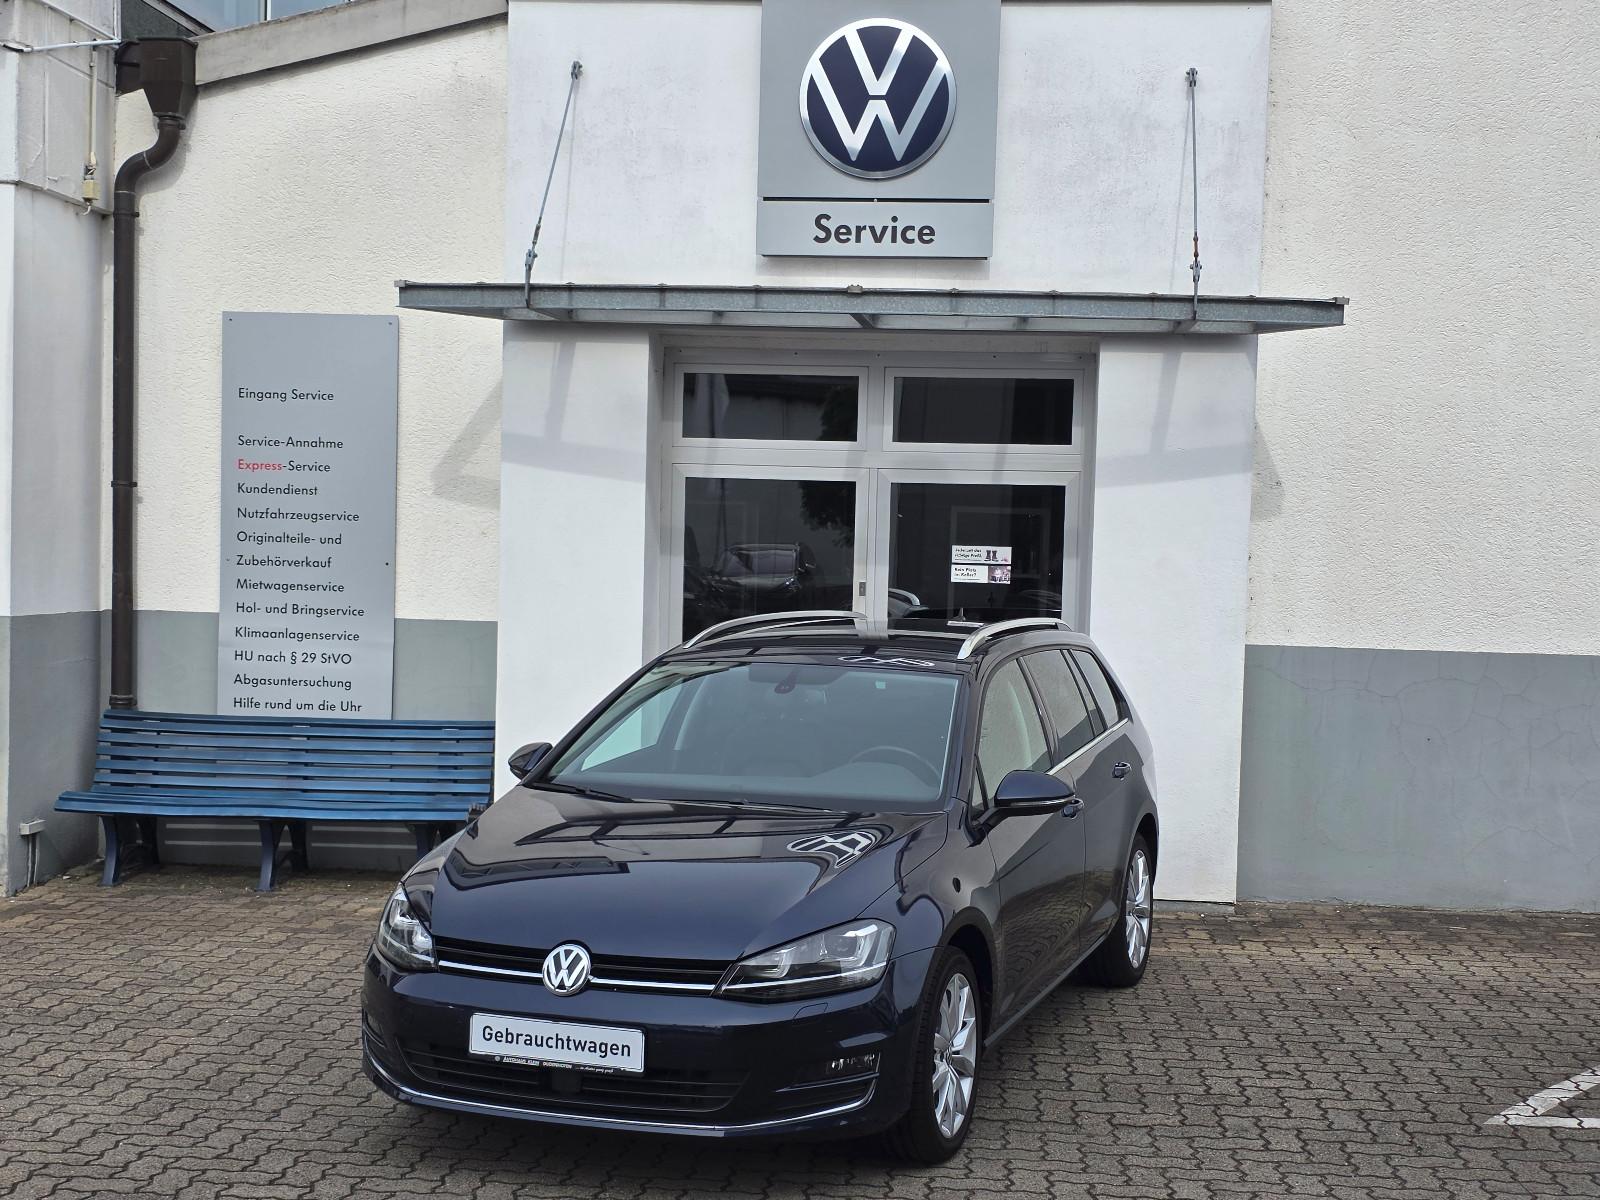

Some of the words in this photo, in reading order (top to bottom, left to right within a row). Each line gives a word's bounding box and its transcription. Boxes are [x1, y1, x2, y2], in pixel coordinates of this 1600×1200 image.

[803, 21, 953, 173] VW
[813, 213, 936, 244] Service
[238, 387, 286, 402] Eingang
[291, 389, 334, 401] Service
[238, 435, 344, 449] Service-Annahme
[238, 459, 331, 472] Express-Service
[237, 482, 318, 496] Kundendienst
[237, 508, 360, 523] Nutzfahrzeugservice
[237, 530, 315, 545] Originalteile-
[319, 533, 342, 545] und
[236, 554, 332, 568] Zubehörverkauf
[236, 578, 345, 593] Mietwagenservice
[236, 602, 261, 613] Hol-
[265, 603, 288, 614] und
[292, 603, 365, 618] Bringservice
[235, 627, 360, 642] Klimaanlagenservice
[234, 650, 253, 661] HU
[257, 651, 286, 662] nach
[291, 652, 297, 665] §
[301, 652, 316, 663] 29
[320, 653, 352, 664] StVO
[233, 674, 352, 690] Abgasuntersuchung
[233, 697, 261, 709] Hilfe
[265, 699, 291, 710] rund
[296, 702, 314, 711] um
[318, 700, 336, 711] die
[340, 701, 362, 712] Uhr
[544, 945, 590, 995] VW
[482, 1025, 631, 1058] Gebrauchtwagen
